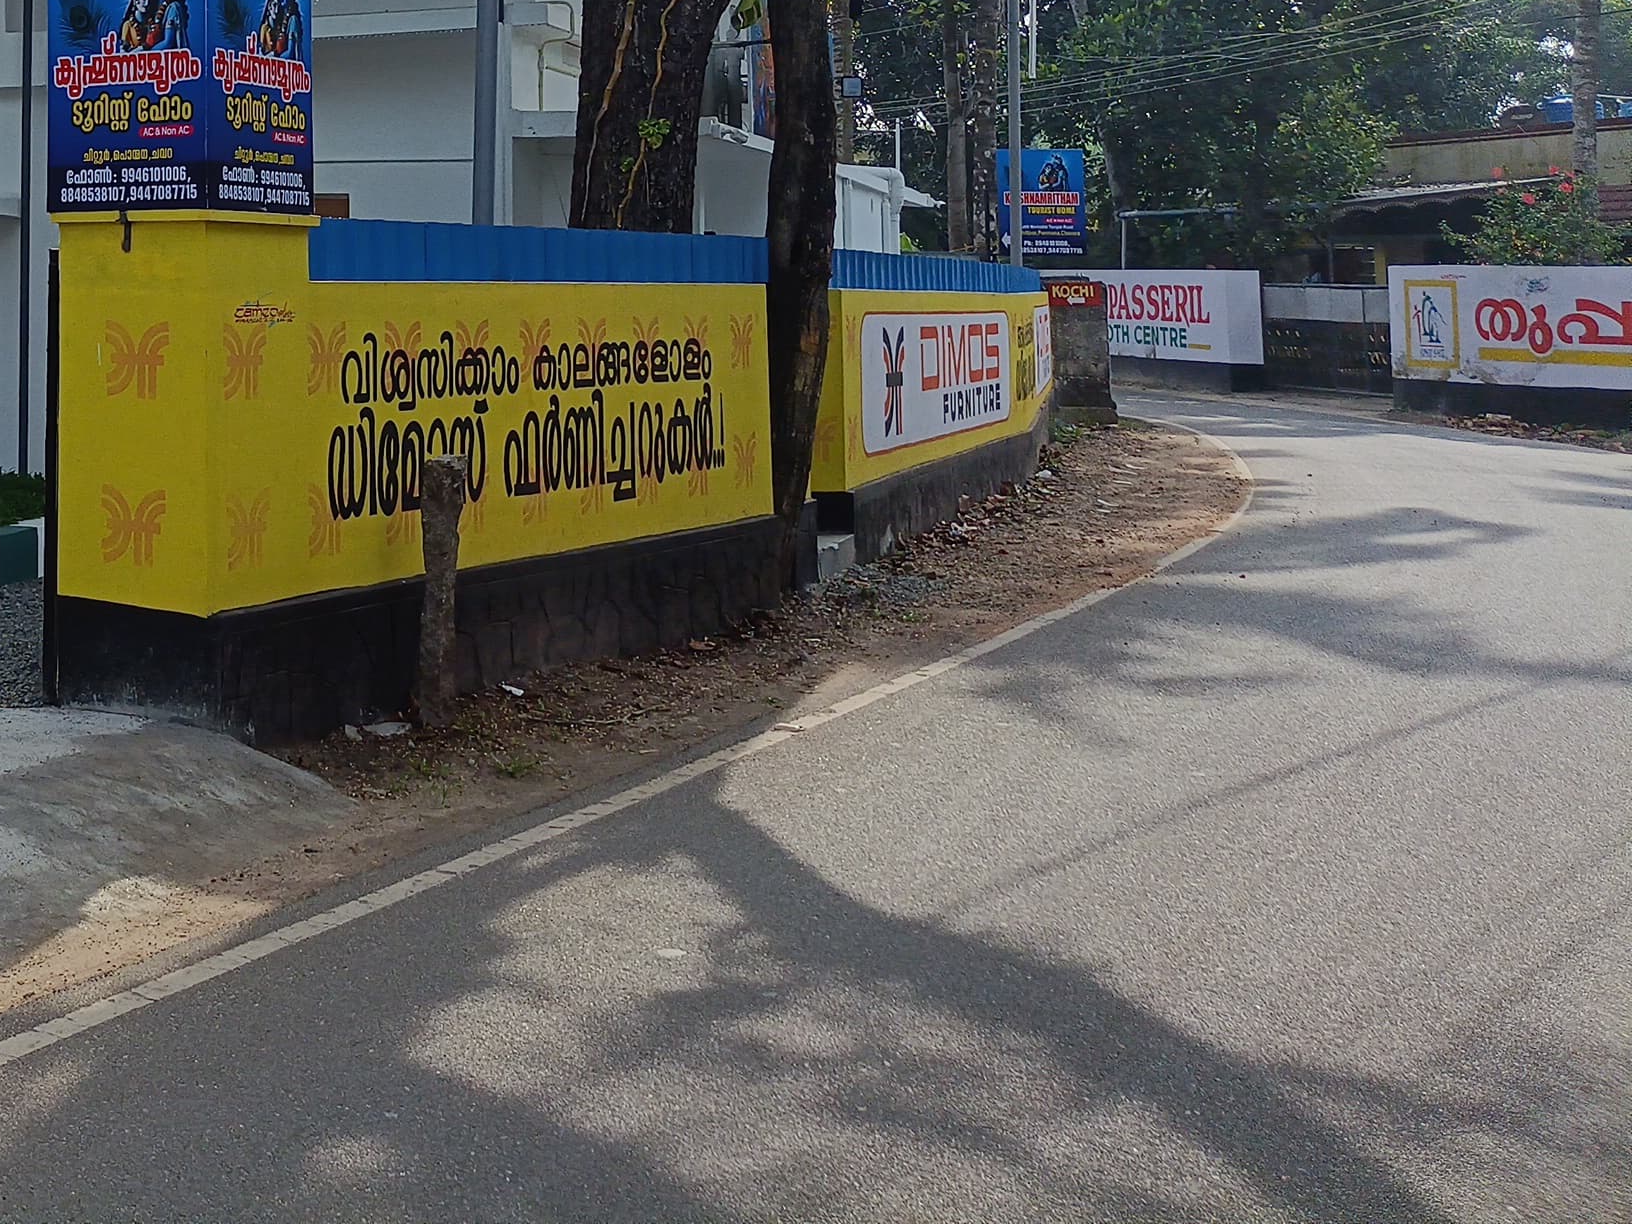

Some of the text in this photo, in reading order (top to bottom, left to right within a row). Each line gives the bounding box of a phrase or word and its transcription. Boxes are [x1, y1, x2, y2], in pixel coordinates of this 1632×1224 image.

[137, 96, 193, 123] ഹോം
[142, 124, 190, 137] AC & Non AC
[274, 132, 282, 142] AC
[286, 133, 296, 143] Non
[296, 134, 304, 144] AC
[121, 164, 192, 185] 9946101006,
[1051, 284, 1095, 298] KOCHI
[1134, 325, 1188, 349] CENTRE
[920, 323, 999, 392] DIMOS
[340, 330, 713, 411] വിശ്വസിക്കാം കാലങ്ങളോളം
[943, 383, 1001, 425] FURNITURE
